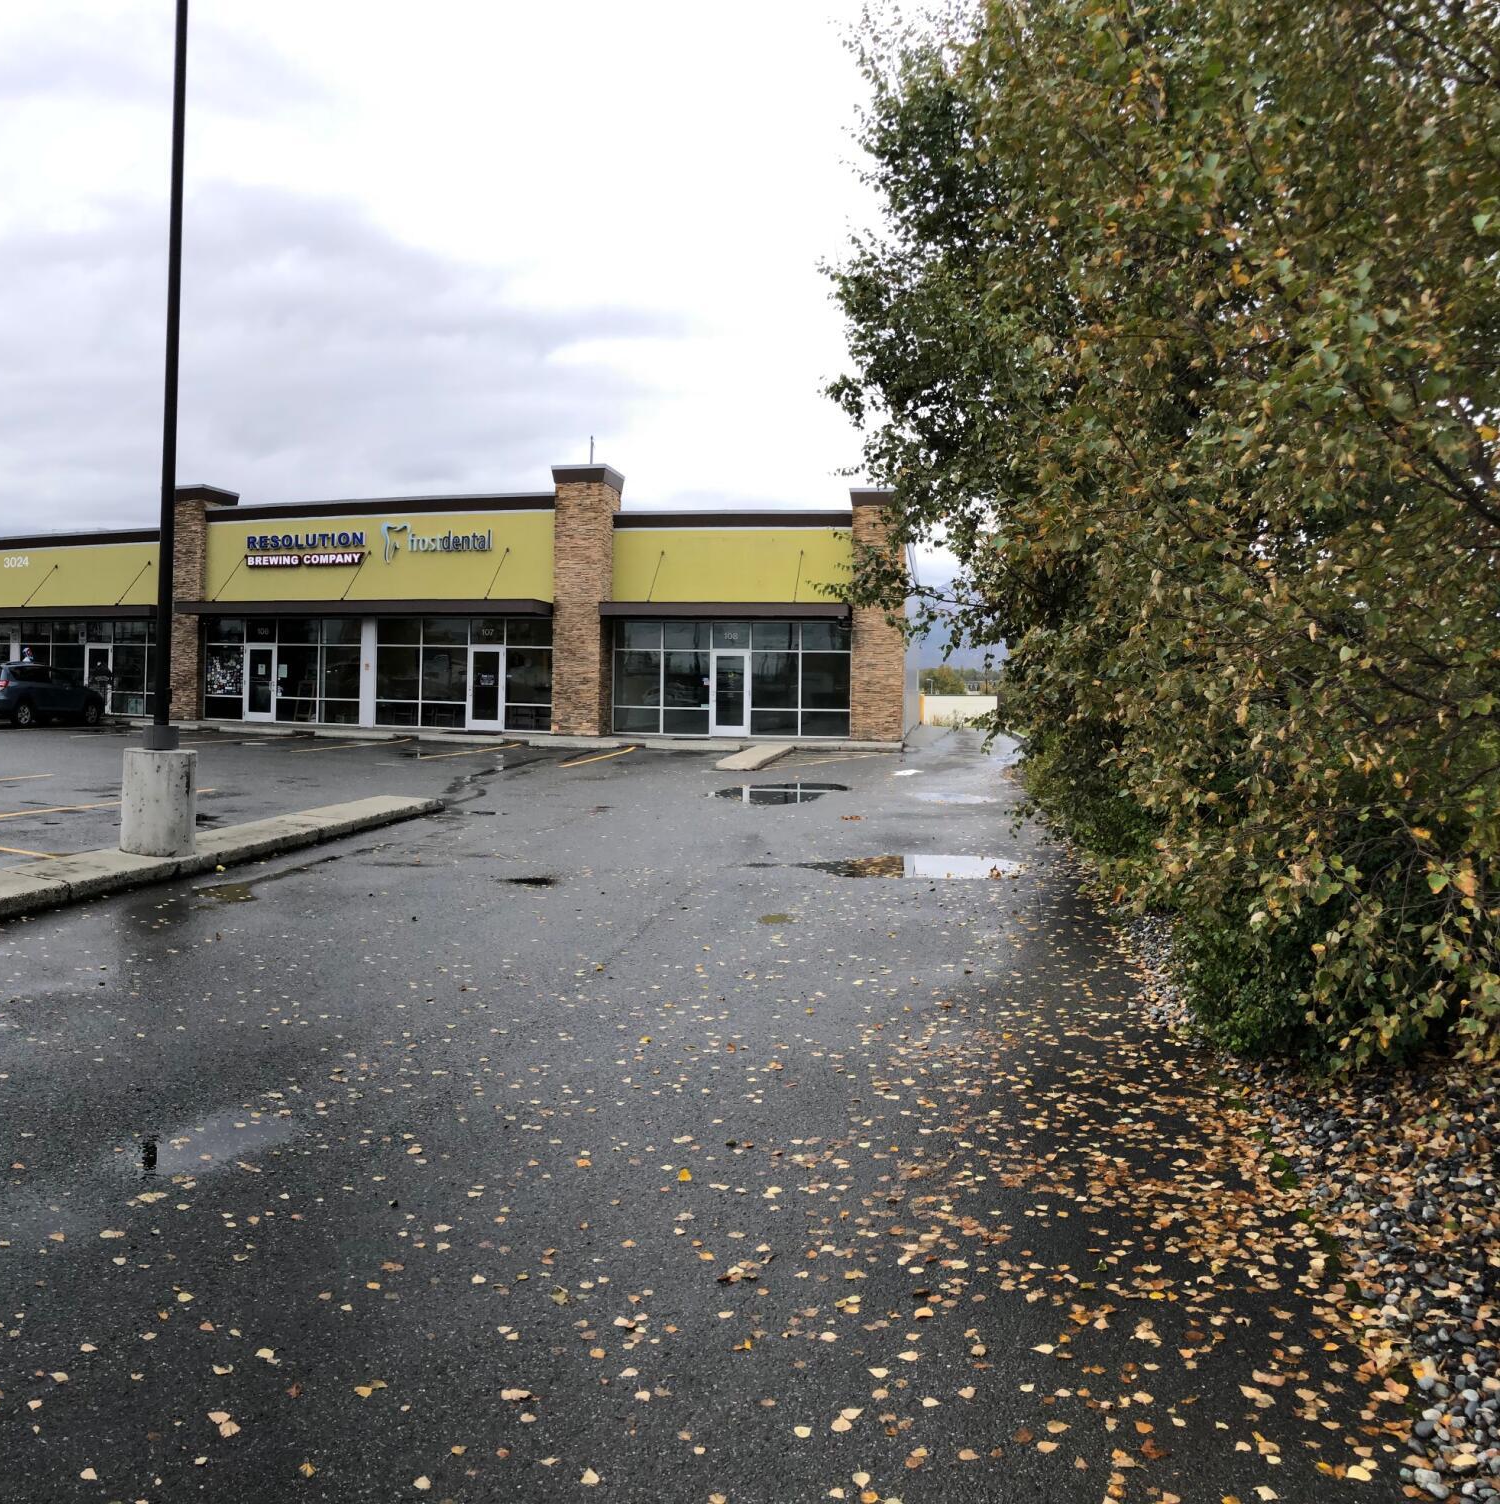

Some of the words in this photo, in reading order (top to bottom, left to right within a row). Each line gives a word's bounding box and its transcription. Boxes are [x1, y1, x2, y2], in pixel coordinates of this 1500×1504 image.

[246, 531, 365, 550] RESOLUTION
[3, 556, 29, 568] 3024
[247, 555, 299, 566] BREWING
[303, 553, 362, 565] COMPANY
[482, 628, 494, 636] 107
